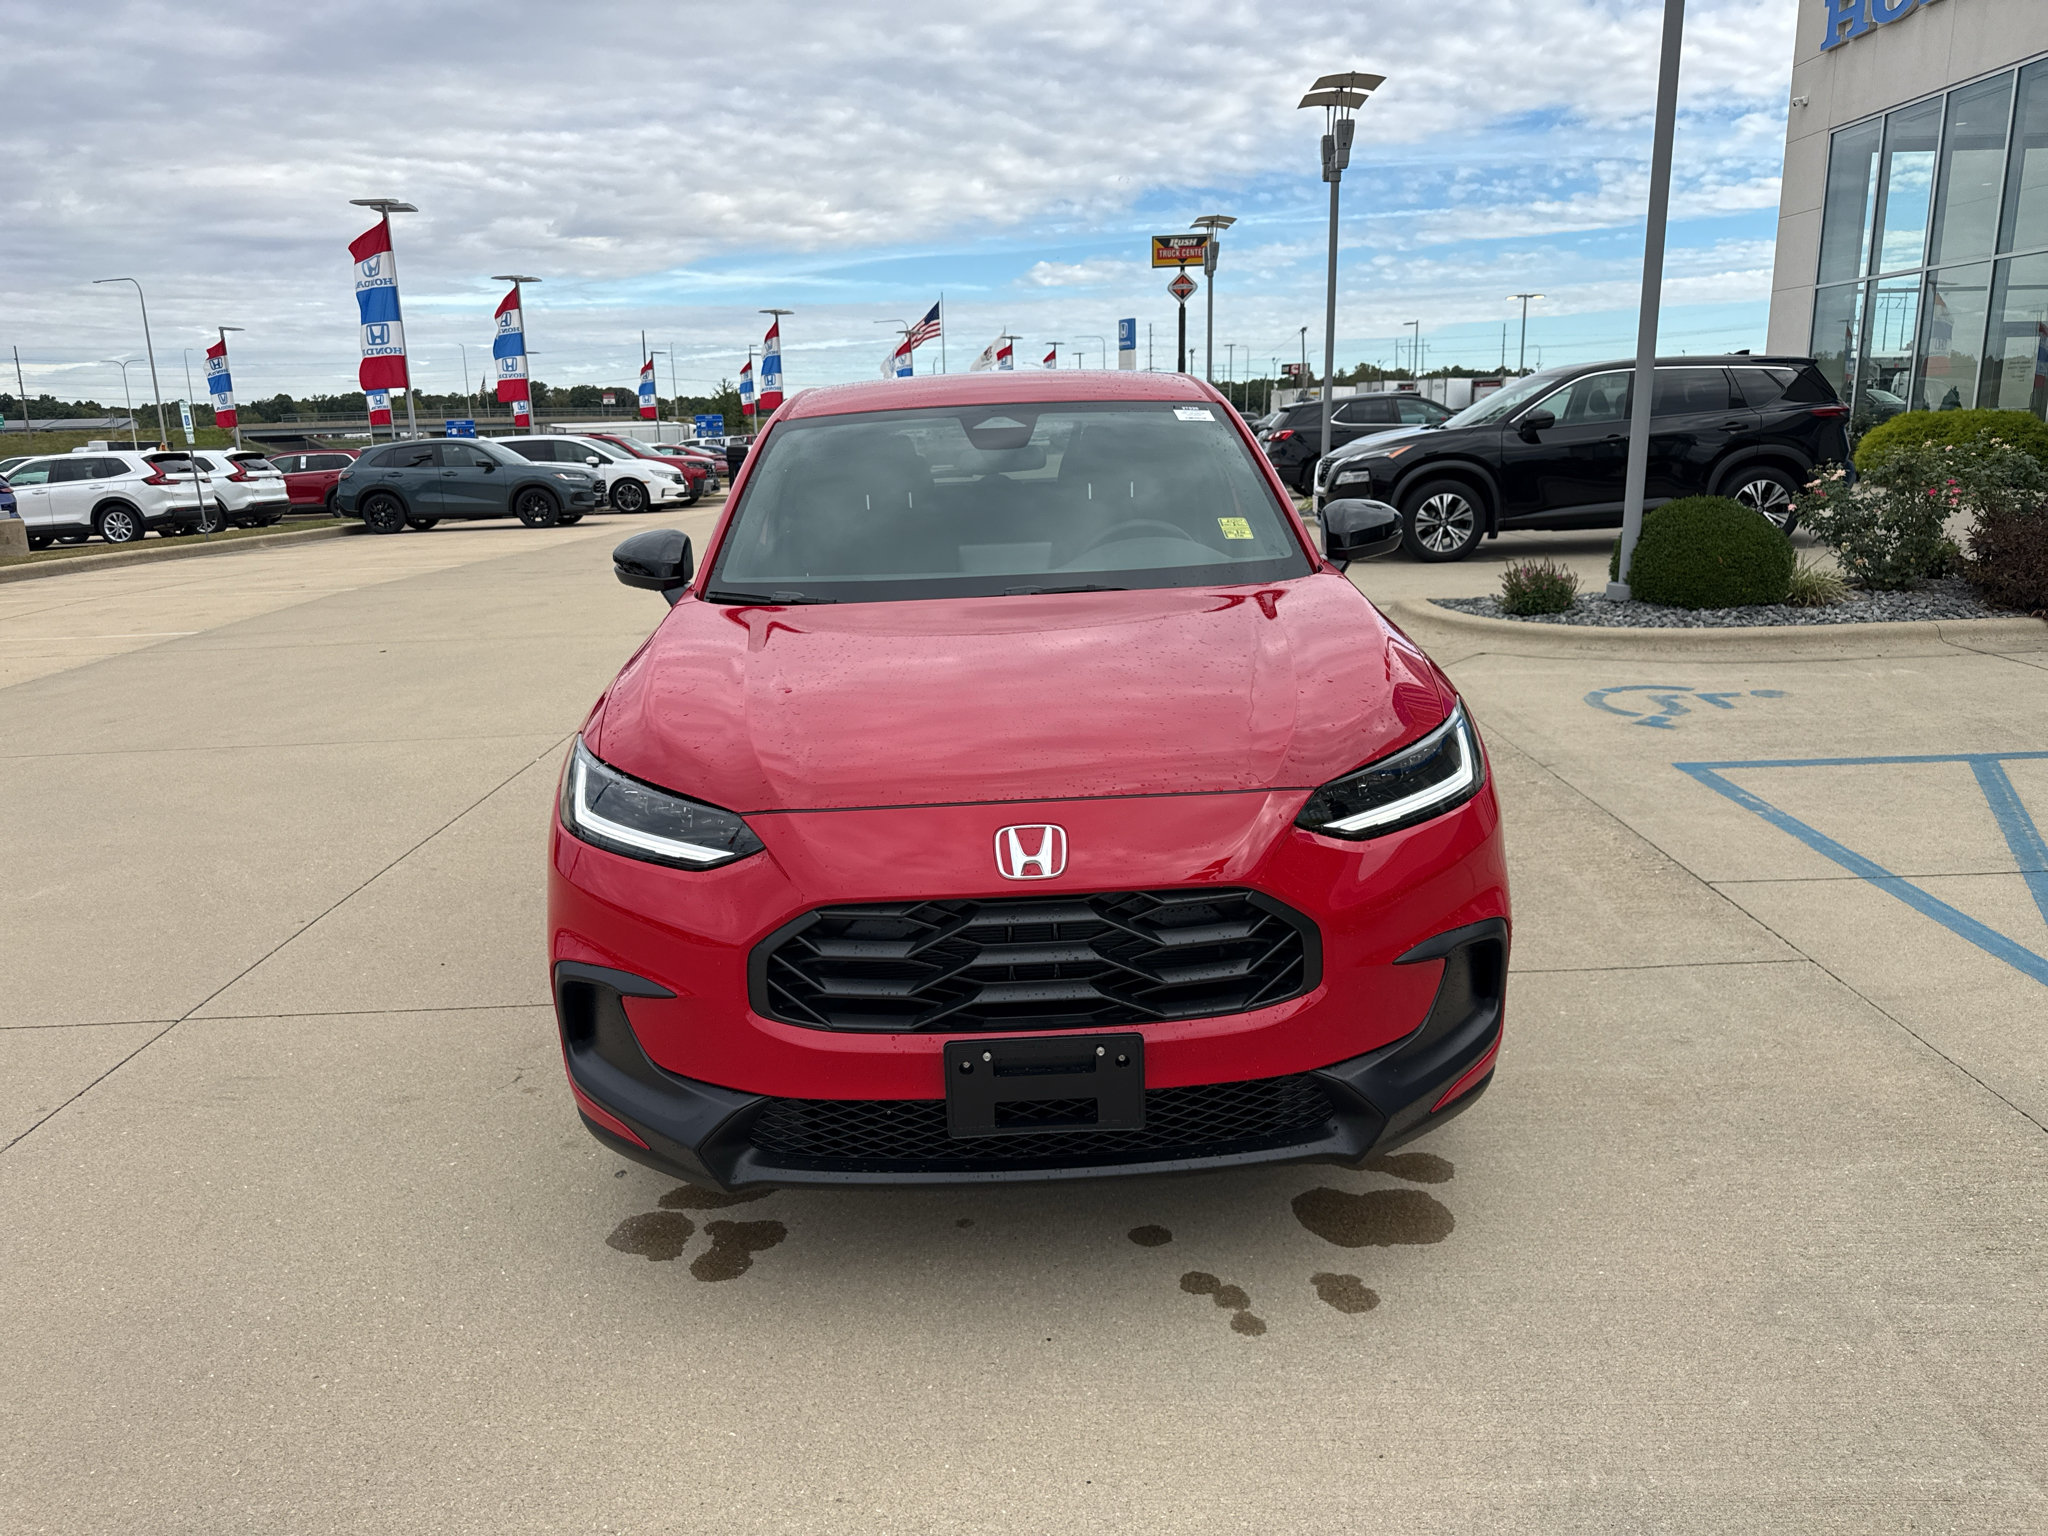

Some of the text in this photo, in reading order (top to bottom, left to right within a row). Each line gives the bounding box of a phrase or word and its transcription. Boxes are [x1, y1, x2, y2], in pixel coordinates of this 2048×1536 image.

[1168, 238, 1197, 249] RUSH
[1159, 247, 1203, 258] TRUCK CENTE
